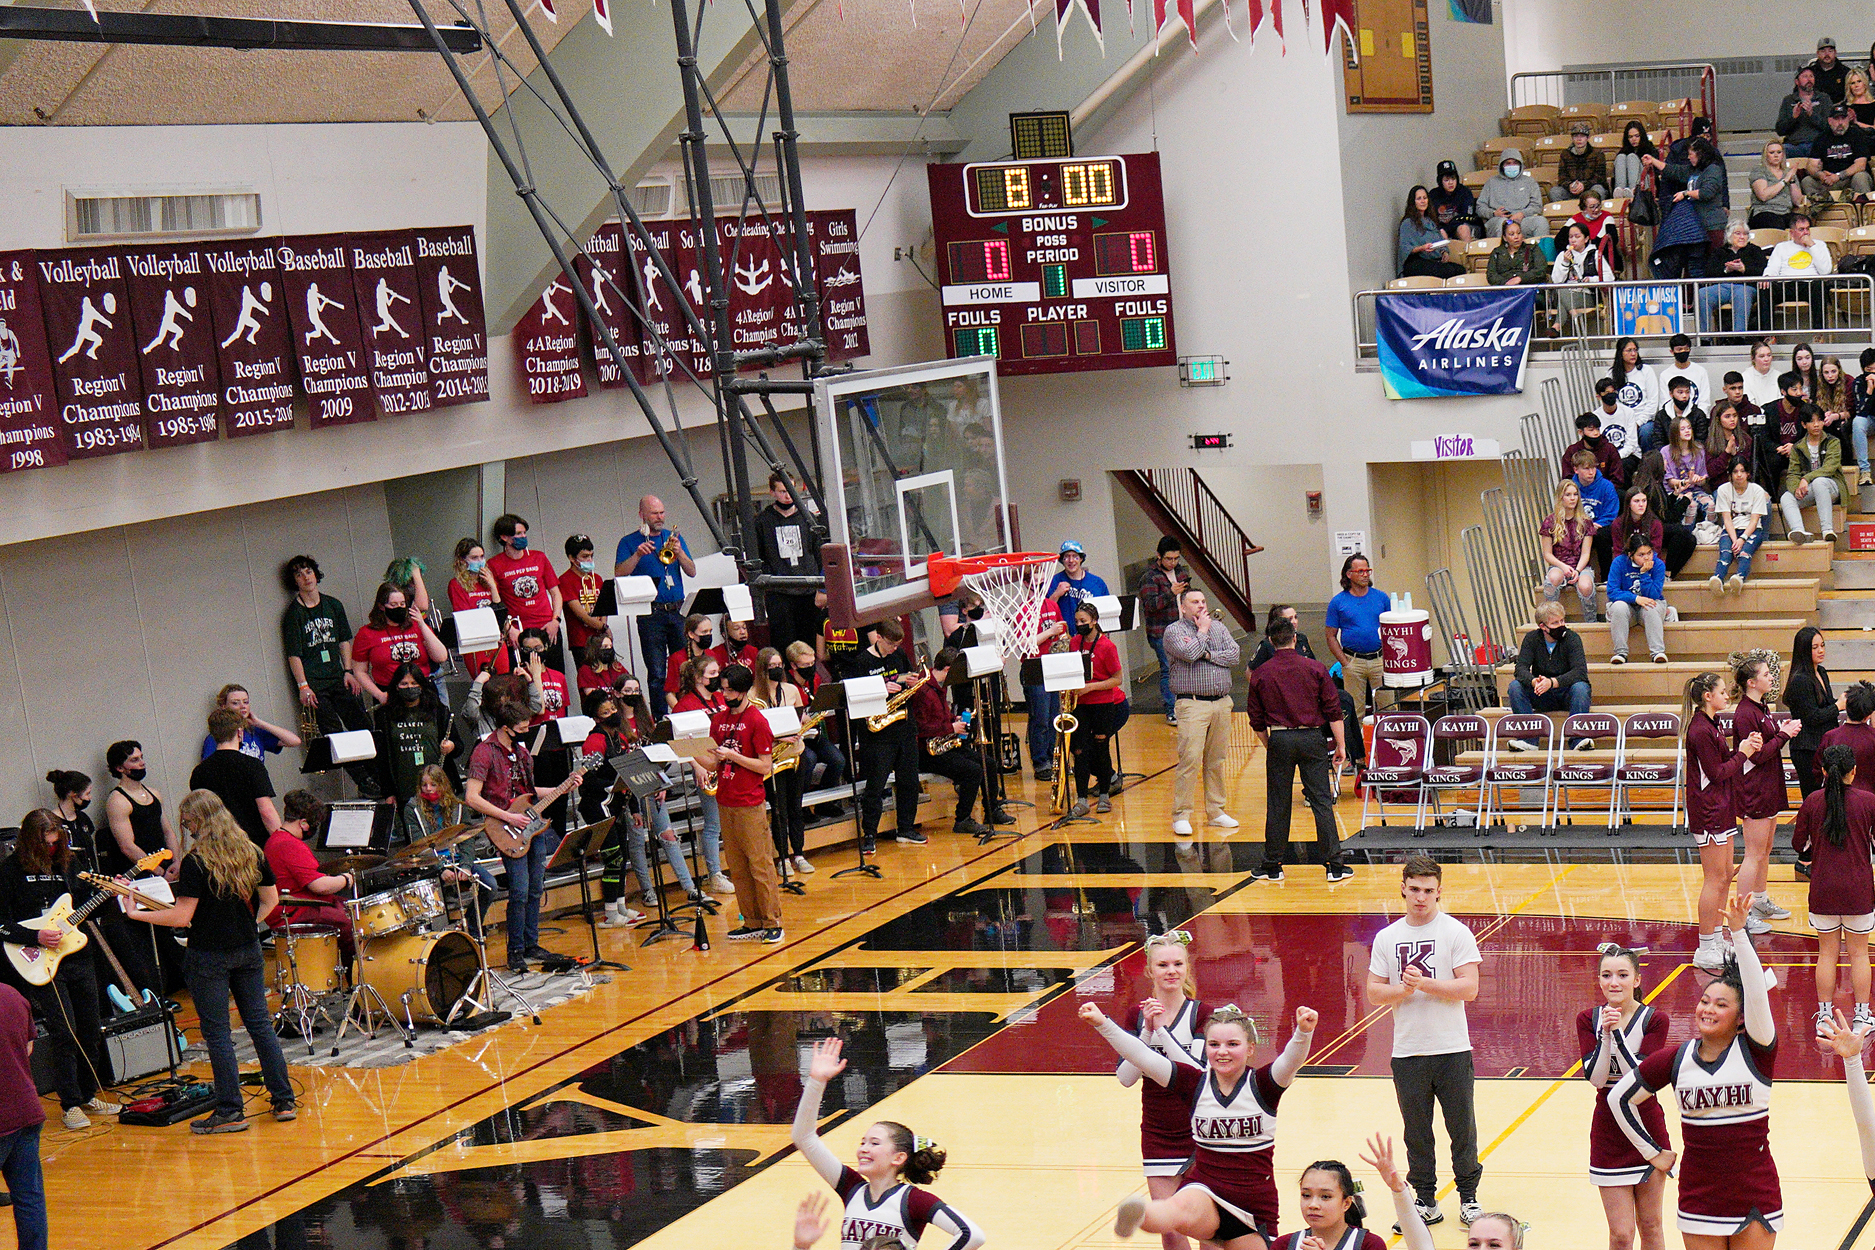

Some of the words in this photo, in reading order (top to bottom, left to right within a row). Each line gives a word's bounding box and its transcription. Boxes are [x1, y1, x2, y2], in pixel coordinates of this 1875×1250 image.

[1004, 163, 1113, 208] 8:00
[829, 222, 848, 236] Girls
[1022, 216, 1077, 232] BONUS
[417, 236, 472, 257] Baseball
[579, 233, 620, 254] oftball
[1037, 235, 1066, 246] POSS
[205, 248, 275, 277] Volleyball
[283, 247, 345, 272] Baseball
[354, 246, 413, 268] Baseball
[984, 240, 1009, 280] 0
[1027, 248, 1078, 263] PERIOD
[1130, 232, 1154, 272] 0
[12, 261, 23, 281] &
[39, 257, 120, 287] Volleyball
[126, 252, 200, 281] Volleyball
[970, 287, 1013, 300] HOME
[1095, 279, 1146, 294] VISITOR
[1618, 288, 1643, 304] WEAR
[1653, 287, 1677, 303] MASK
[830, 298, 855, 315] Region
[1028, 305, 1087, 321] PLAYER
[1115, 300, 1167, 316] FOULS
[948, 310, 1000, 326] FOULS
[432, 336, 473, 355] Region
[473, 333, 481, 350] V
[1144, 318, 1164, 349] 0
[1411, 317, 1522, 352] Alaska
[234, 359, 275, 380] Region
[275, 356, 281, 374] V
[303, 353, 345, 375] Region
[347, 351, 357, 369] V
[374, 350, 415, 370] Region
[415, 346, 425, 364] V
[1418, 355, 1513, 370] AIRLINES
[156, 366, 198, 387] Region
[198, 364, 205, 381] V
[1193, 360, 1215, 380] EXIT
[72, 376, 119, 397] Region
[119, 373, 127, 391] V
[225, 382, 293, 405] Champions
[304, 373, 368, 395] Champions
[0, 397, 32, 418] egion
[34, 394, 42, 410] V
[147, 389, 218, 413] Champions
[320, 397, 353, 419] 2009
[62, 401, 141, 424] Champions
[235, 404, 293, 428] 2015-2016
[0, 423, 55, 446] hampions
[158, 413, 217, 437] 1985-1986
[74, 424, 142, 449] 1983-1984
[11, 450, 43, 468] 1998
[1383, 627, 1413, 635] KAYHI
[1385, 659, 1417, 668] KINGS
[1383, 722, 1419, 731] KAYHI
[1442, 722, 1478, 731] KAYHI
[1505, 720, 1542, 730] KAYHI
[1573, 721, 1610, 730] KAYHI
[1633, 720, 1672, 730] KAYHI
[1367, 772, 1400, 780] KINGS
[1429, 774, 1460, 782] KINGS
[1494, 771, 1528, 779] KINGS
[1560, 770, 1593, 779] KINGS
[1626, 771, 1658, 779] KINGS
[1395, 940, 1437, 980] K
[1679, 1082, 1754, 1110] KAYHI
[1194, 1113, 1264, 1140] KAYHI
